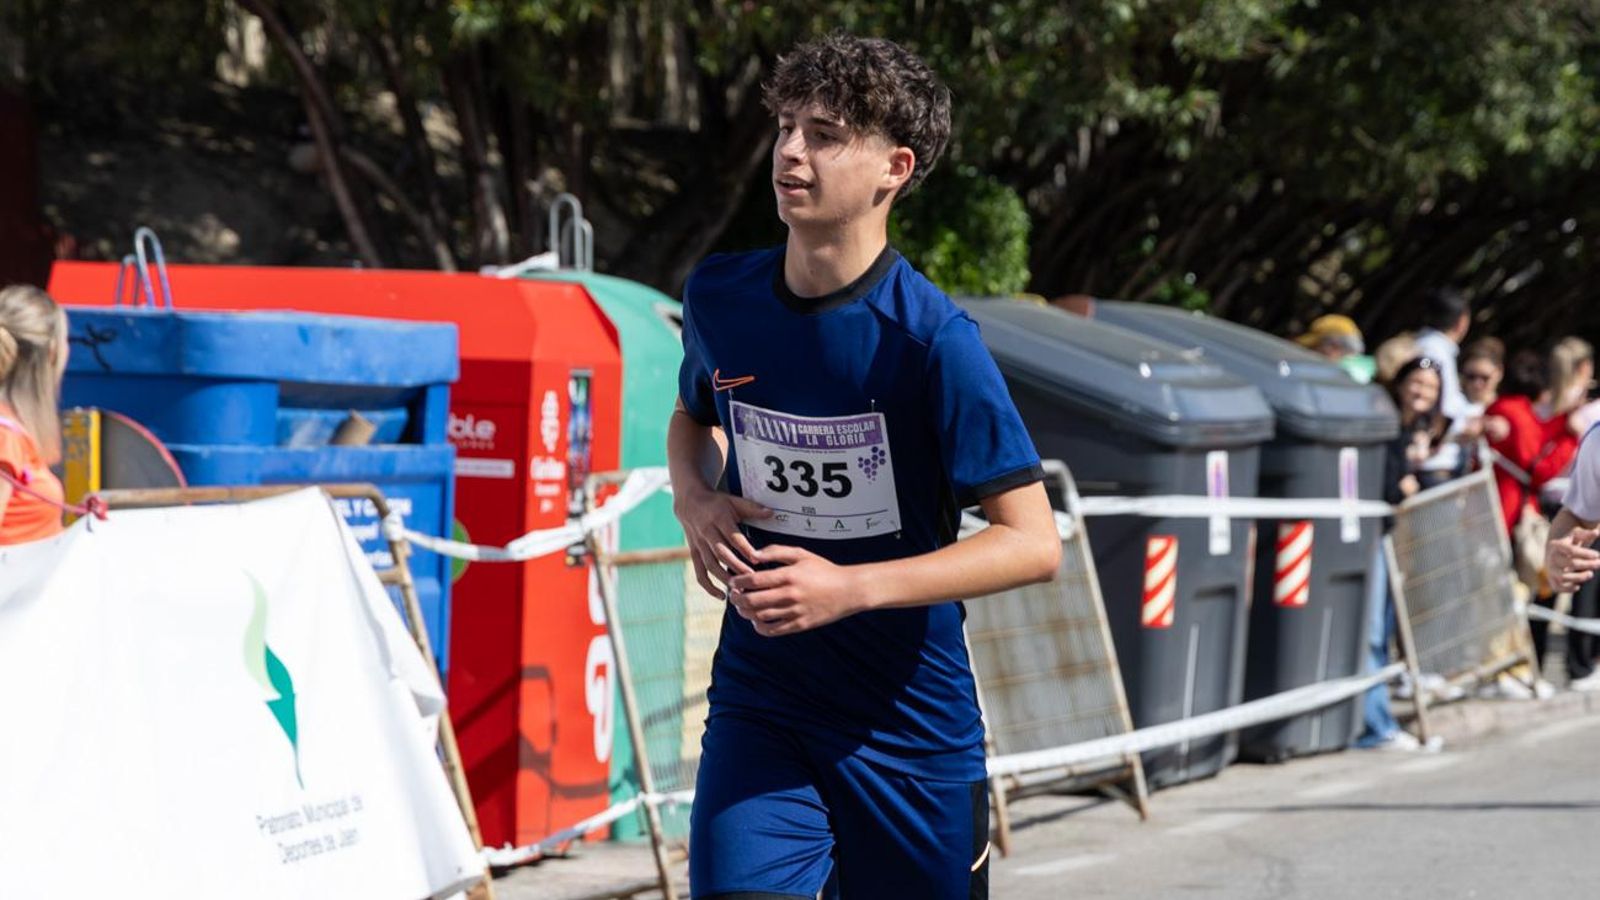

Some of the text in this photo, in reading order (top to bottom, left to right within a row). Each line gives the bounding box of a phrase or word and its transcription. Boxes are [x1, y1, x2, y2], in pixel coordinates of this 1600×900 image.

[797, 420, 876, 435] CARRERA ESCOLAR
[806, 433, 866, 446] LA GLORIA
[764, 455, 853, 498] 335
[351, 795, 363, 812] de
[277, 838, 324, 864] Deportes
[324, 834, 337, 851] de
